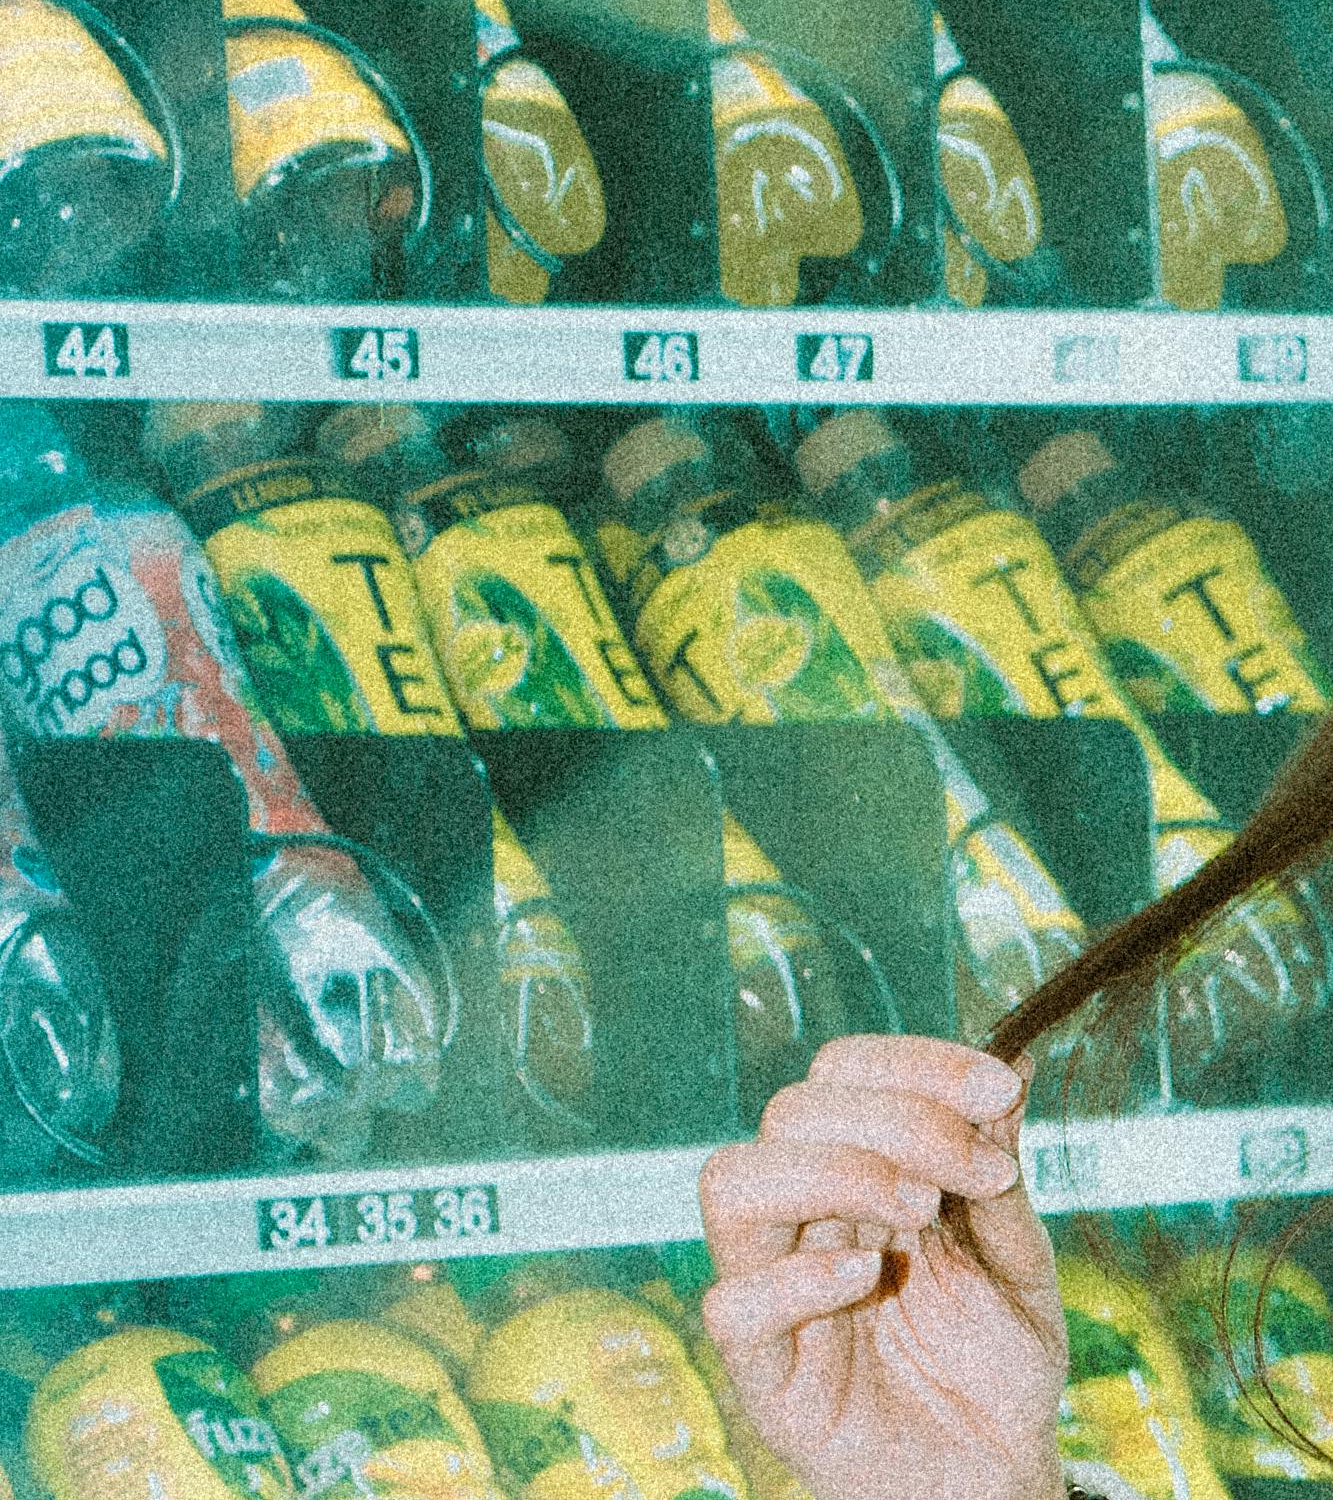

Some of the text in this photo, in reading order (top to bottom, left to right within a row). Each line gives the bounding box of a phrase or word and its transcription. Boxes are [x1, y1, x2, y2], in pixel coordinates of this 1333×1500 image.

[55, 325, 121, 378] 44
[350, 329, 413, 381] 45
[632, 334, 693, 383] 46
[808, 335, 869, 384] 47
[270, 1187, 492, 1251] 34 35 36
